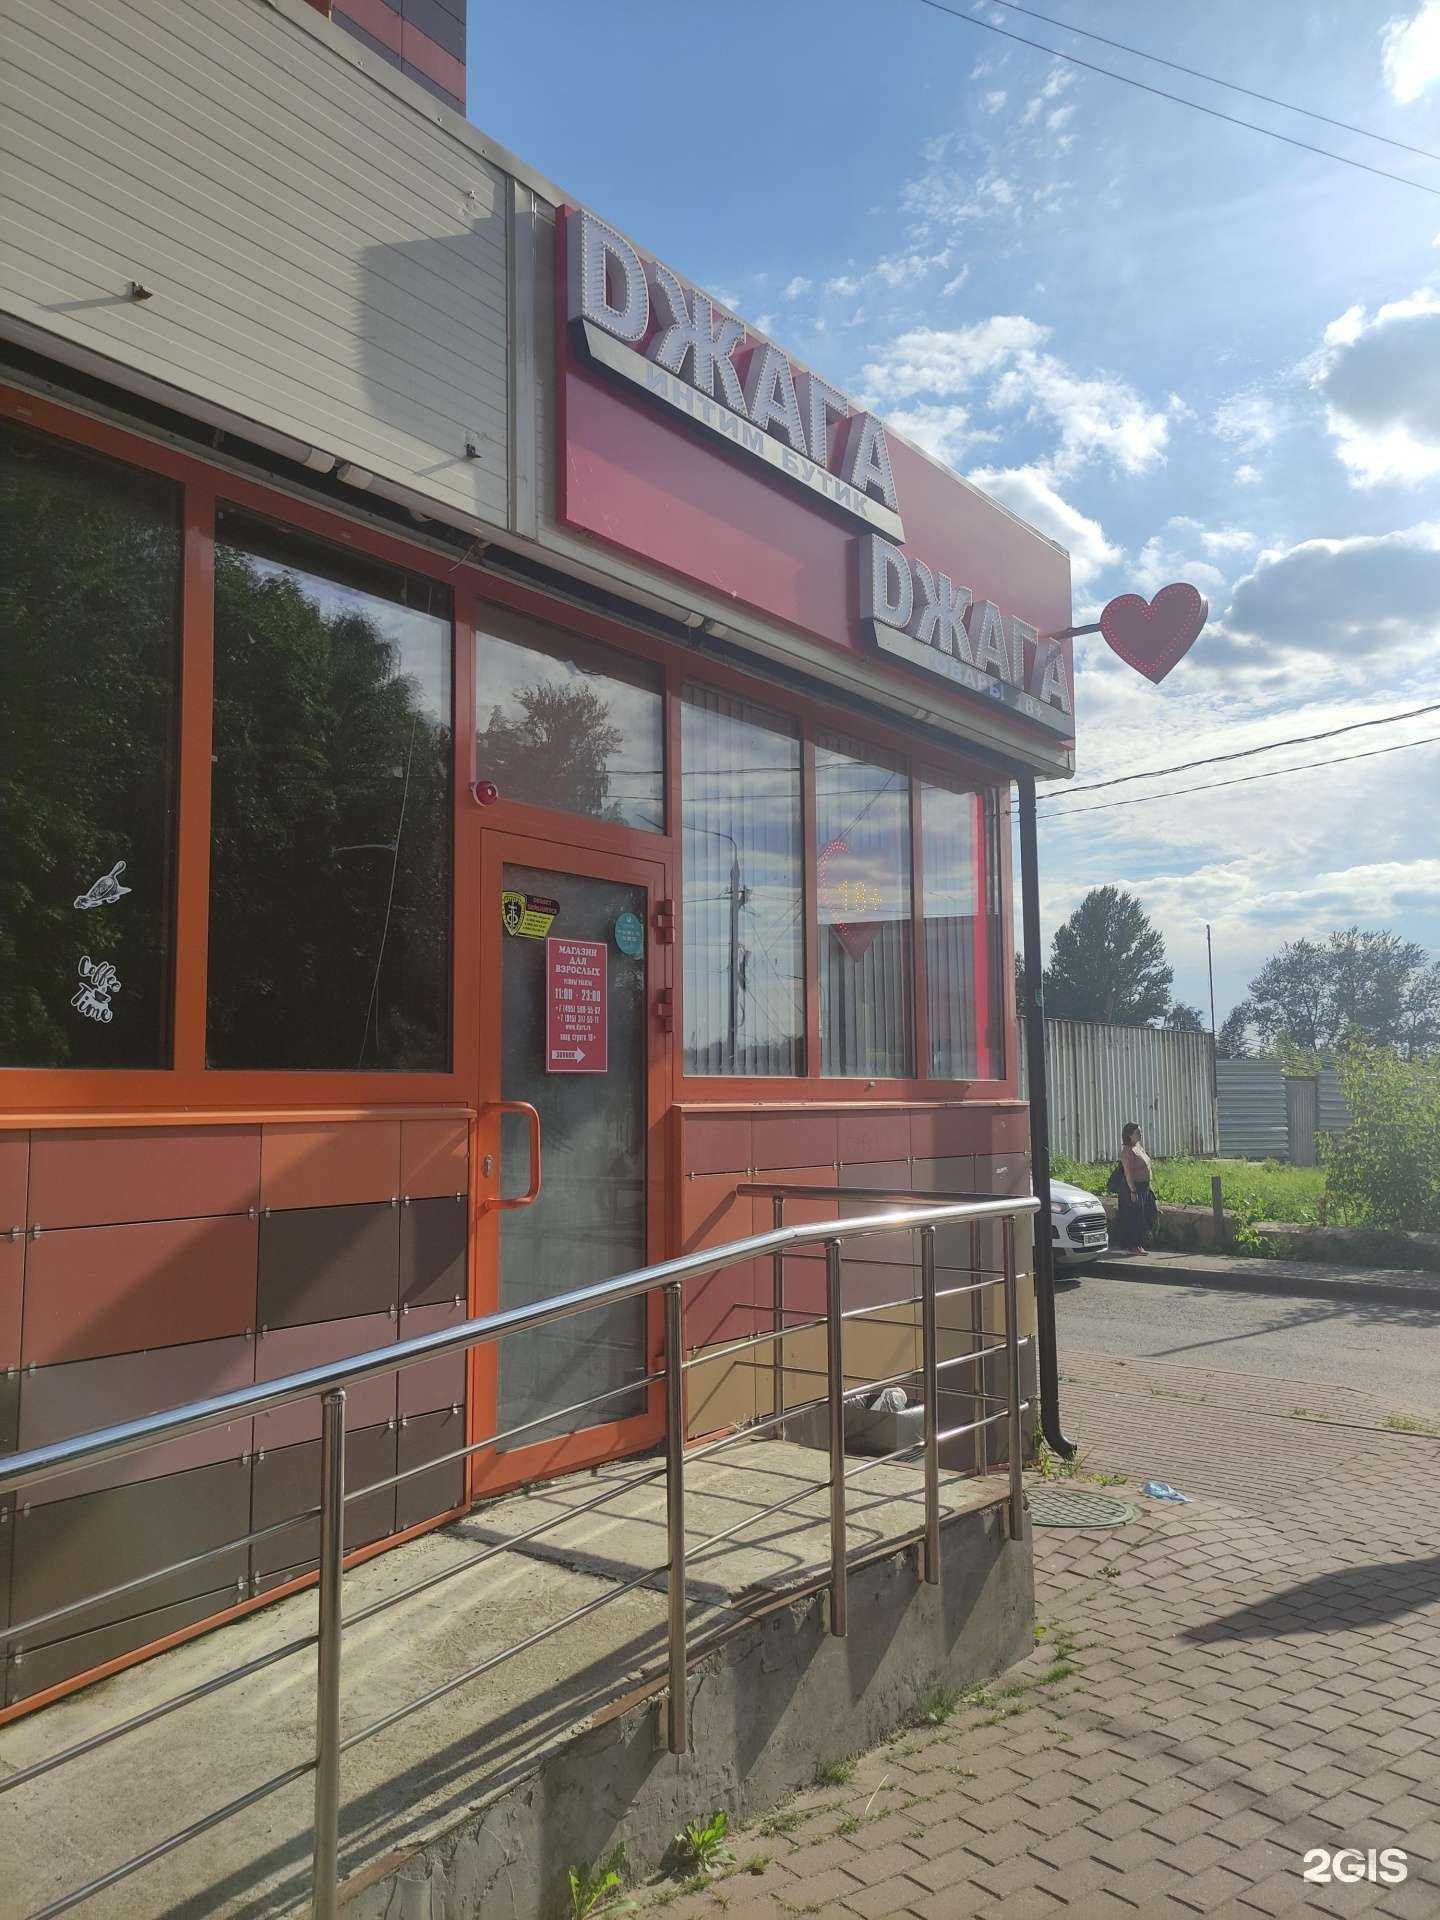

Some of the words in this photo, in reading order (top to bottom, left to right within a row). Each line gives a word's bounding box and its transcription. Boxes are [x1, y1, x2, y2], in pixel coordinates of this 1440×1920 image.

[645, 363, 765, 452] ИНТИМ
[781, 449, 869, 517] БУТИК
[839, 880, 882, 912] 18+
[559, 946, 597, 957] МАГАЗИН
[569, 956, 587, 965] ДЛЯ
[78, 956, 121, 992] Coffee
[555, 964, 600, 976] ВЗРОСЛЫХ
[71, 983, 113, 1023] Time
[555, 988, 573, 1000] 11:00
[581, 989, 601, 1002] 23:00
